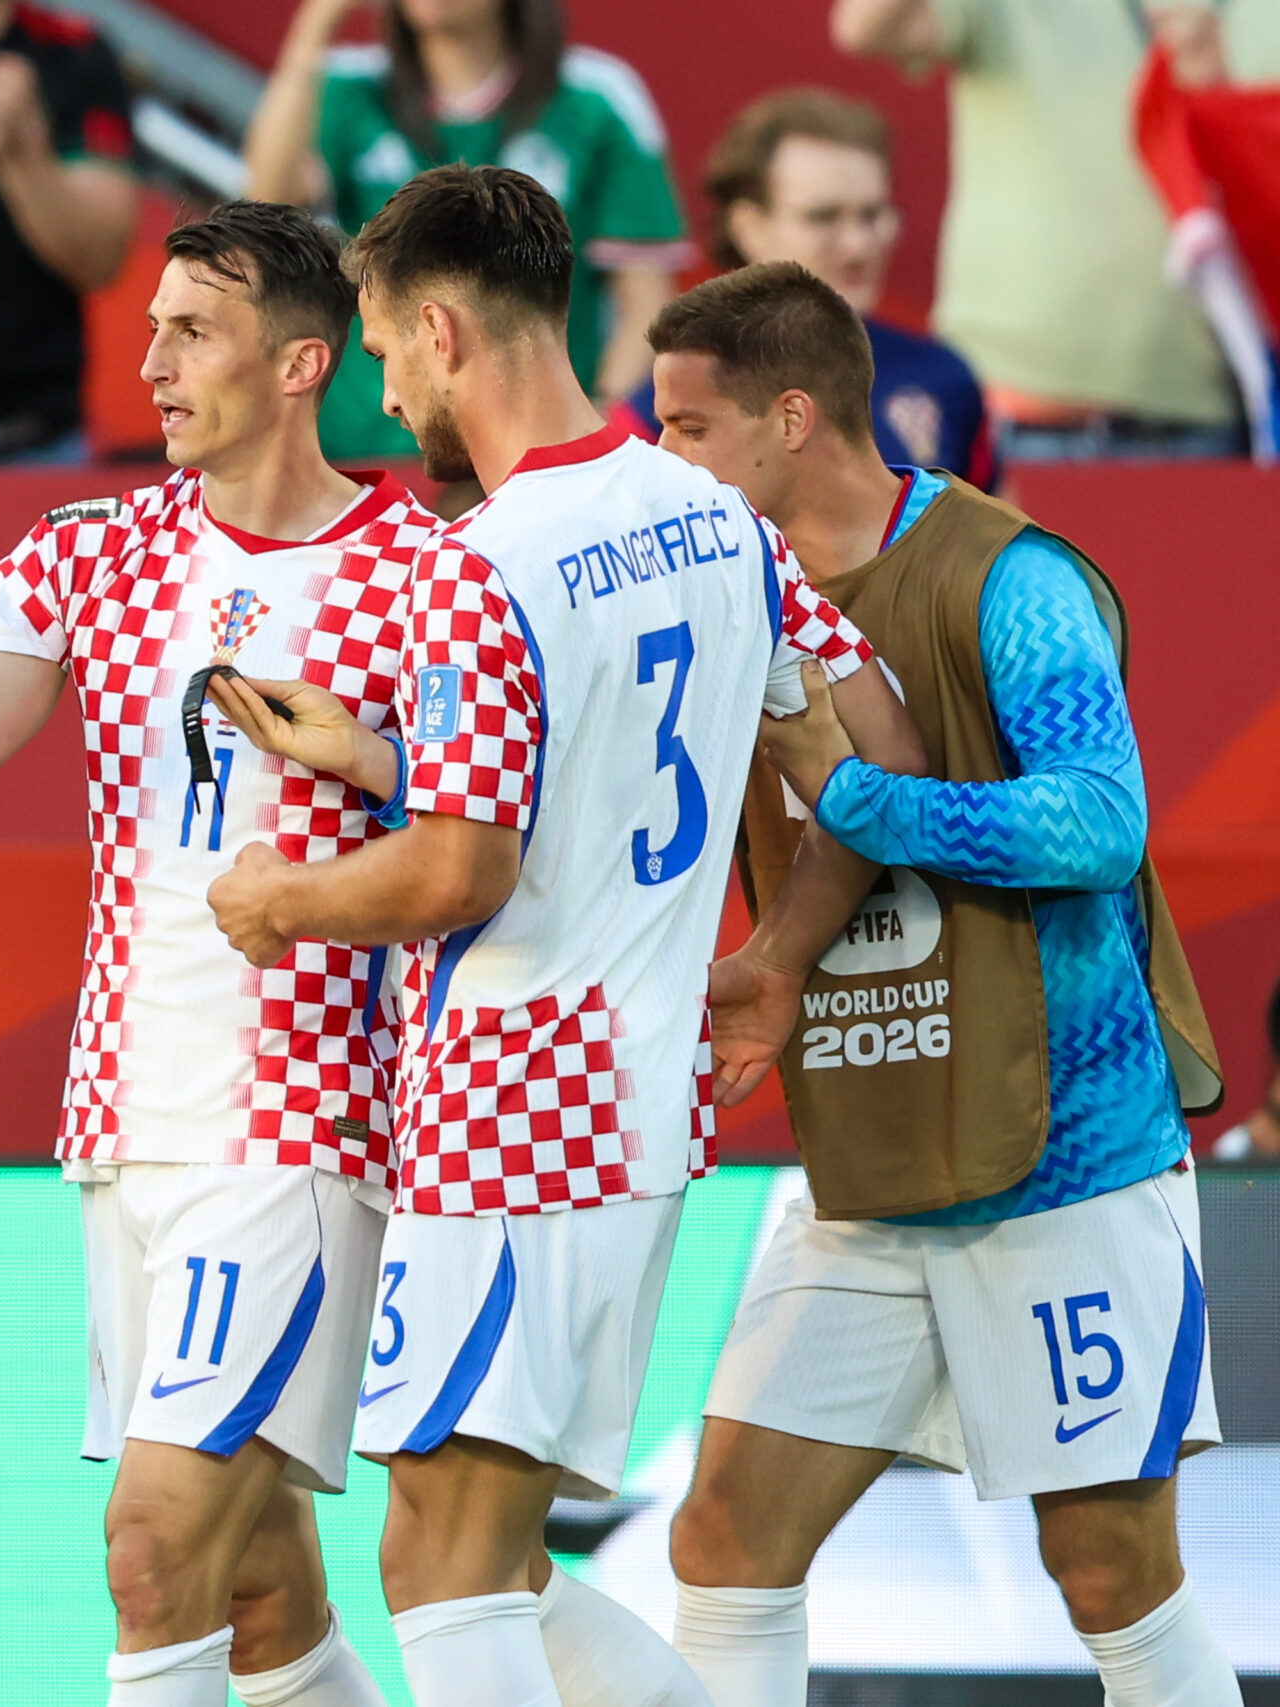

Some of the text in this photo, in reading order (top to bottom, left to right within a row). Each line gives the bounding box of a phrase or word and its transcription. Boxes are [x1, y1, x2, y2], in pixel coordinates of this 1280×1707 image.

[557, 499, 739, 609] PONGRAČĆ
[631, 621, 708, 886] 3
[802, 1013, 951, 1070] 2026
[803, 979, 950, 1019] WORLD CUP
[177, 1256, 241, 1366] 11
[371, 1261, 407, 1367] 3
[1031, 1291, 1124, 1405] 15
